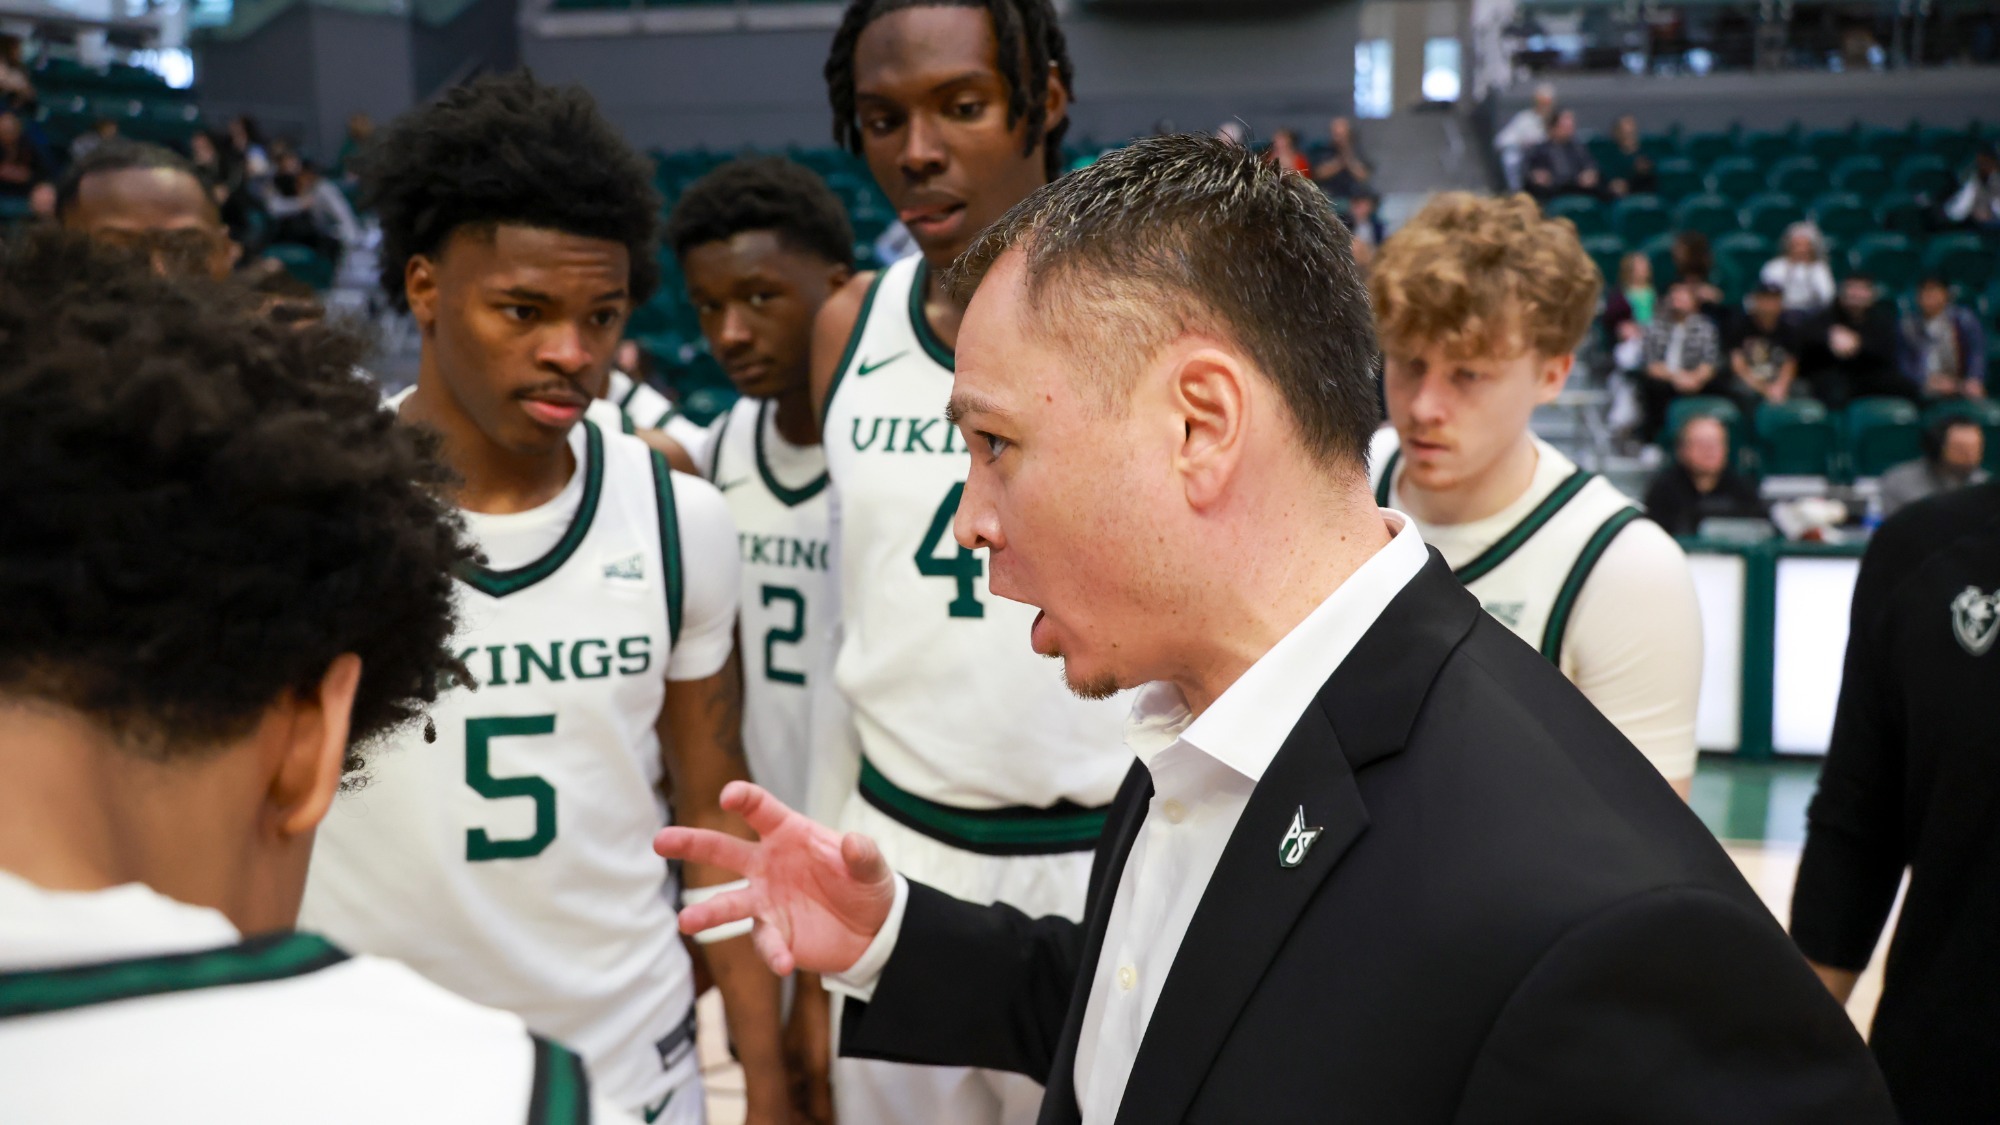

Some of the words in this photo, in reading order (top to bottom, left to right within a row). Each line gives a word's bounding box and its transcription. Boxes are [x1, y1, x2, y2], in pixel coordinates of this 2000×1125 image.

[852, 417, 971, 454] VIKI
[913, 481, 984, 619] 4
[761, 584, 806, 686] 2
[466, 714, 557, 861] 5
